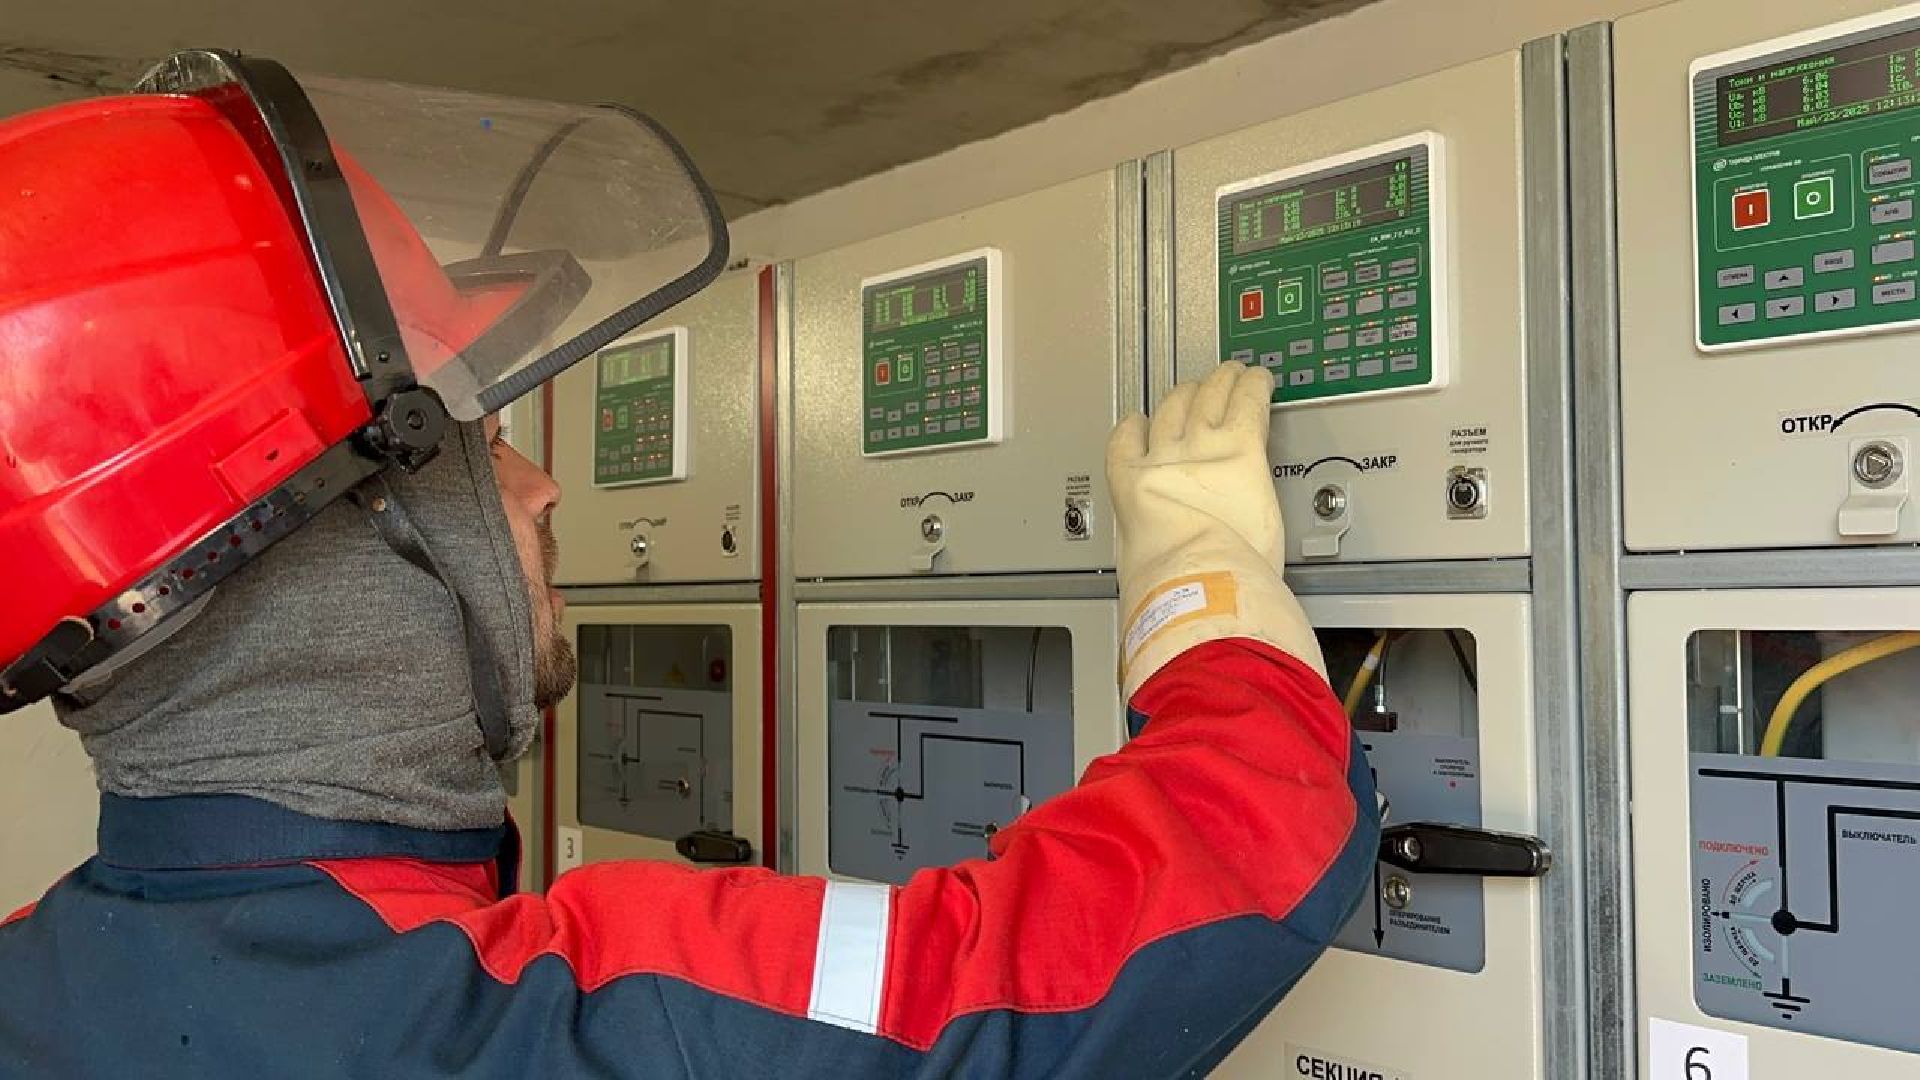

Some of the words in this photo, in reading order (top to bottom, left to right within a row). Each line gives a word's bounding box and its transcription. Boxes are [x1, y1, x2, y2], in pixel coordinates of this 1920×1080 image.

[1782, 414, 1832, 433] ОТКР
[1273, 464, 1304, 478] ОТКР
[1362, 456, 1396, 470] ЗАКР
[1841, 828, 1917, 845] ВЫКЛЮЧАТЕЛЬ
[1699, 840, 1769, 856] ПОДКЛЮЧЕНО
[1701, 878, 1711, 953] ИЗОЛИРОВАНО
[1703, 972, 1763, 991] ЗАЗЕМЛЕНО
[1684, 1046, 1712, 1080] 6
